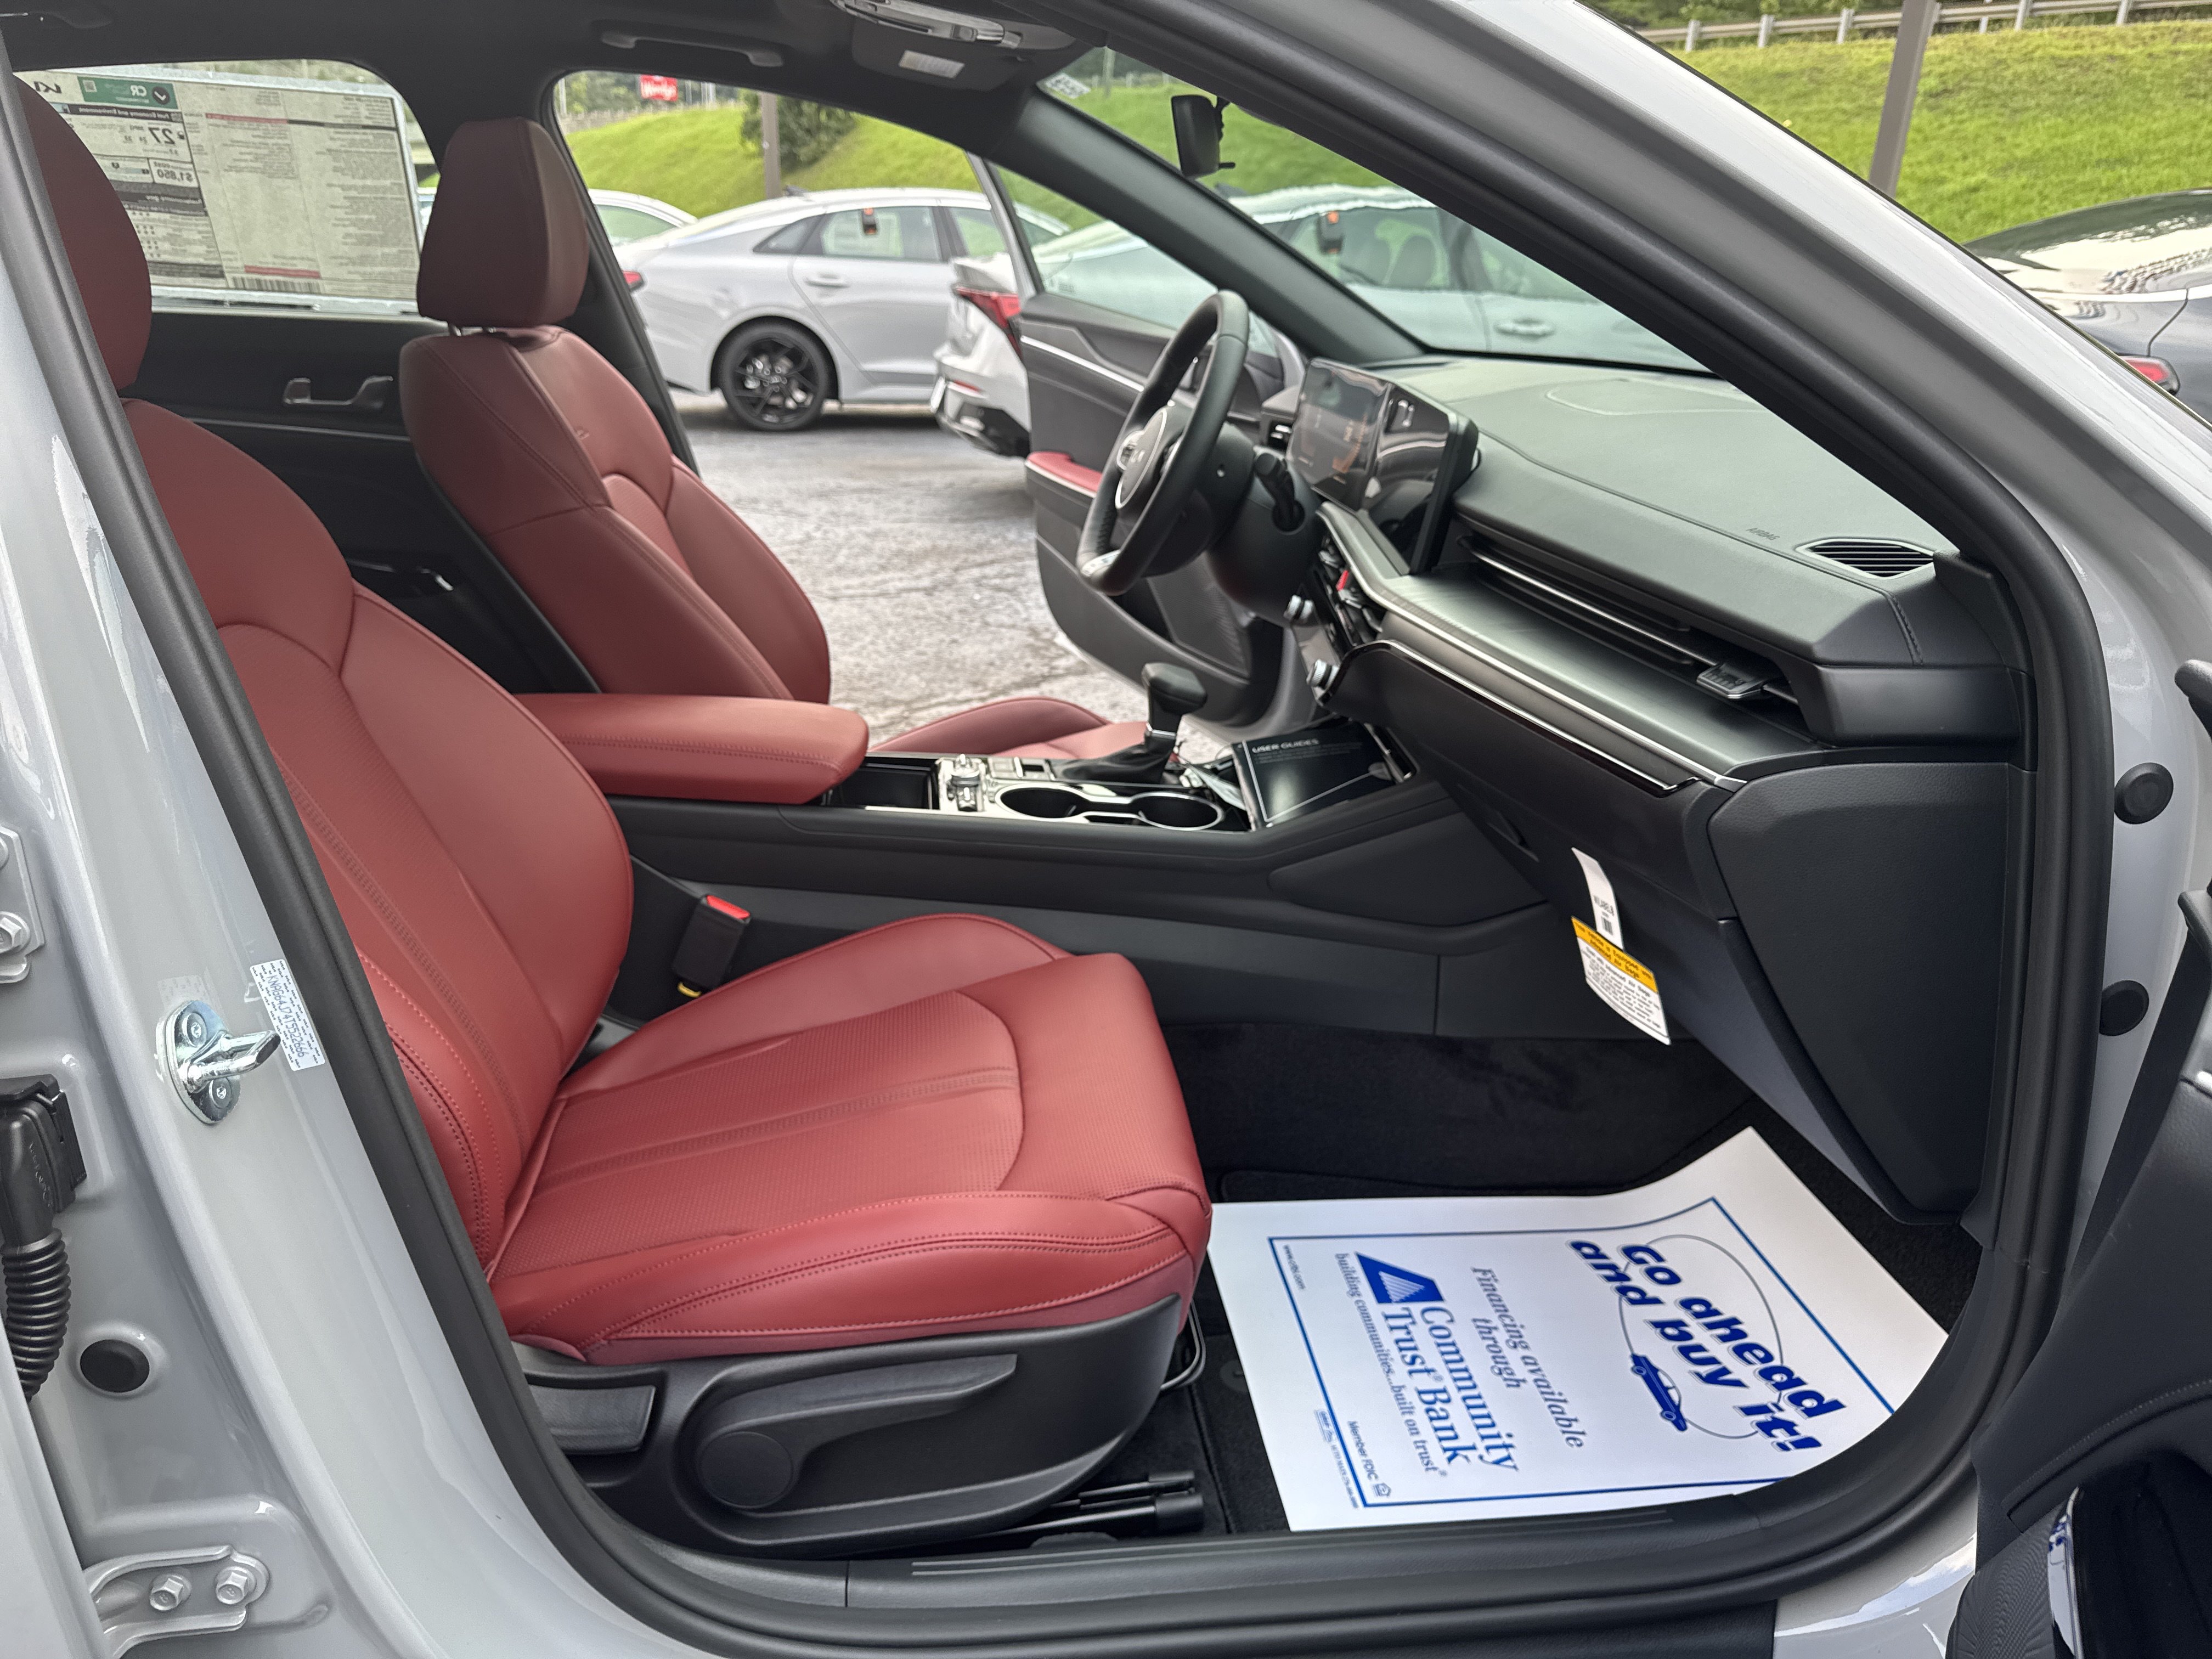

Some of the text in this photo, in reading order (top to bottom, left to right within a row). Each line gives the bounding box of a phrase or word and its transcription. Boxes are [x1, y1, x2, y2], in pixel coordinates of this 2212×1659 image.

[1746, 528, 1780, 540] AIRBAG
[1251, 743, 1280, 753] USER
[1280, 738, 1319, 749] GUIDES
[1335, 1252, 1361, 1299] building
[1404, 1418, 1420, 1437] on
[1420, 1306, 1520, 1472] Community
[1471, 1317, 1528, 1389] through
[1471, 1266, 1588, 1449] Financing available
[1566, 1240, 1822, 1452] and buy it!
[1617, 1244, 1847, 1419] Go ahead
[1347, 1420, 1368, 1457] Member
[1362, 1459, 1379, 1481] FDIC
[1414, 1385, 1478, 1465] Bank
